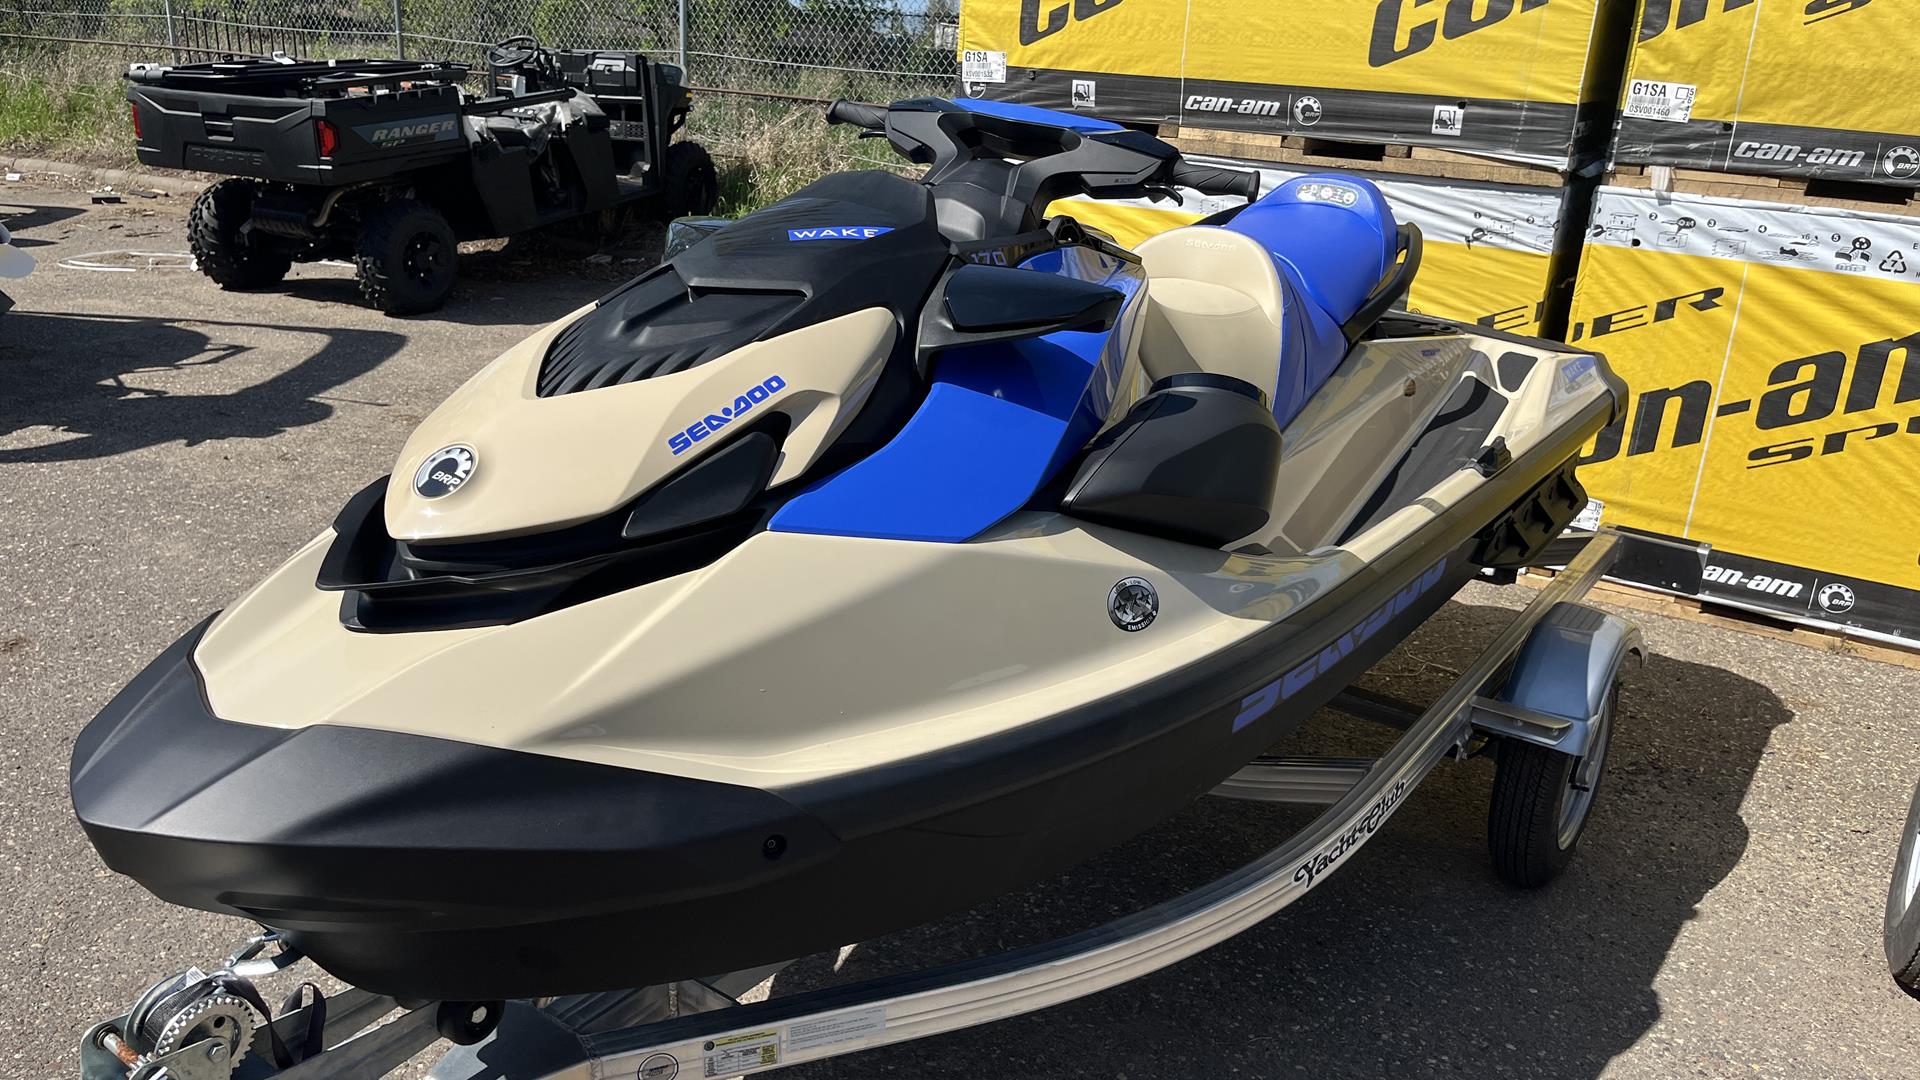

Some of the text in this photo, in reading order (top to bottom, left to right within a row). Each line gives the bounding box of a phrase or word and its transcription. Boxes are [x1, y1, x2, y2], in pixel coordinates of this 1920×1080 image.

[965, 51, 988, 62] G1SA
[1633, 82, 1667, 97] G1SA
[1184, 95, 1281, 116] can-am
[372, 119, 456, 142] RANGER
[1733, 141, 1866, 167] can-am
[1896, 162, 1918, 170] BRP
[793, 228, 879, 239] WAKE
[970, 251, 1007, 266] 170
[431, 470, 461, 486] BRP
[1701, 564, 1803, 598] an-am
[1831, 598, 1852, 607] BRP
[1293, 781, 1405, 888] Yacht Club
